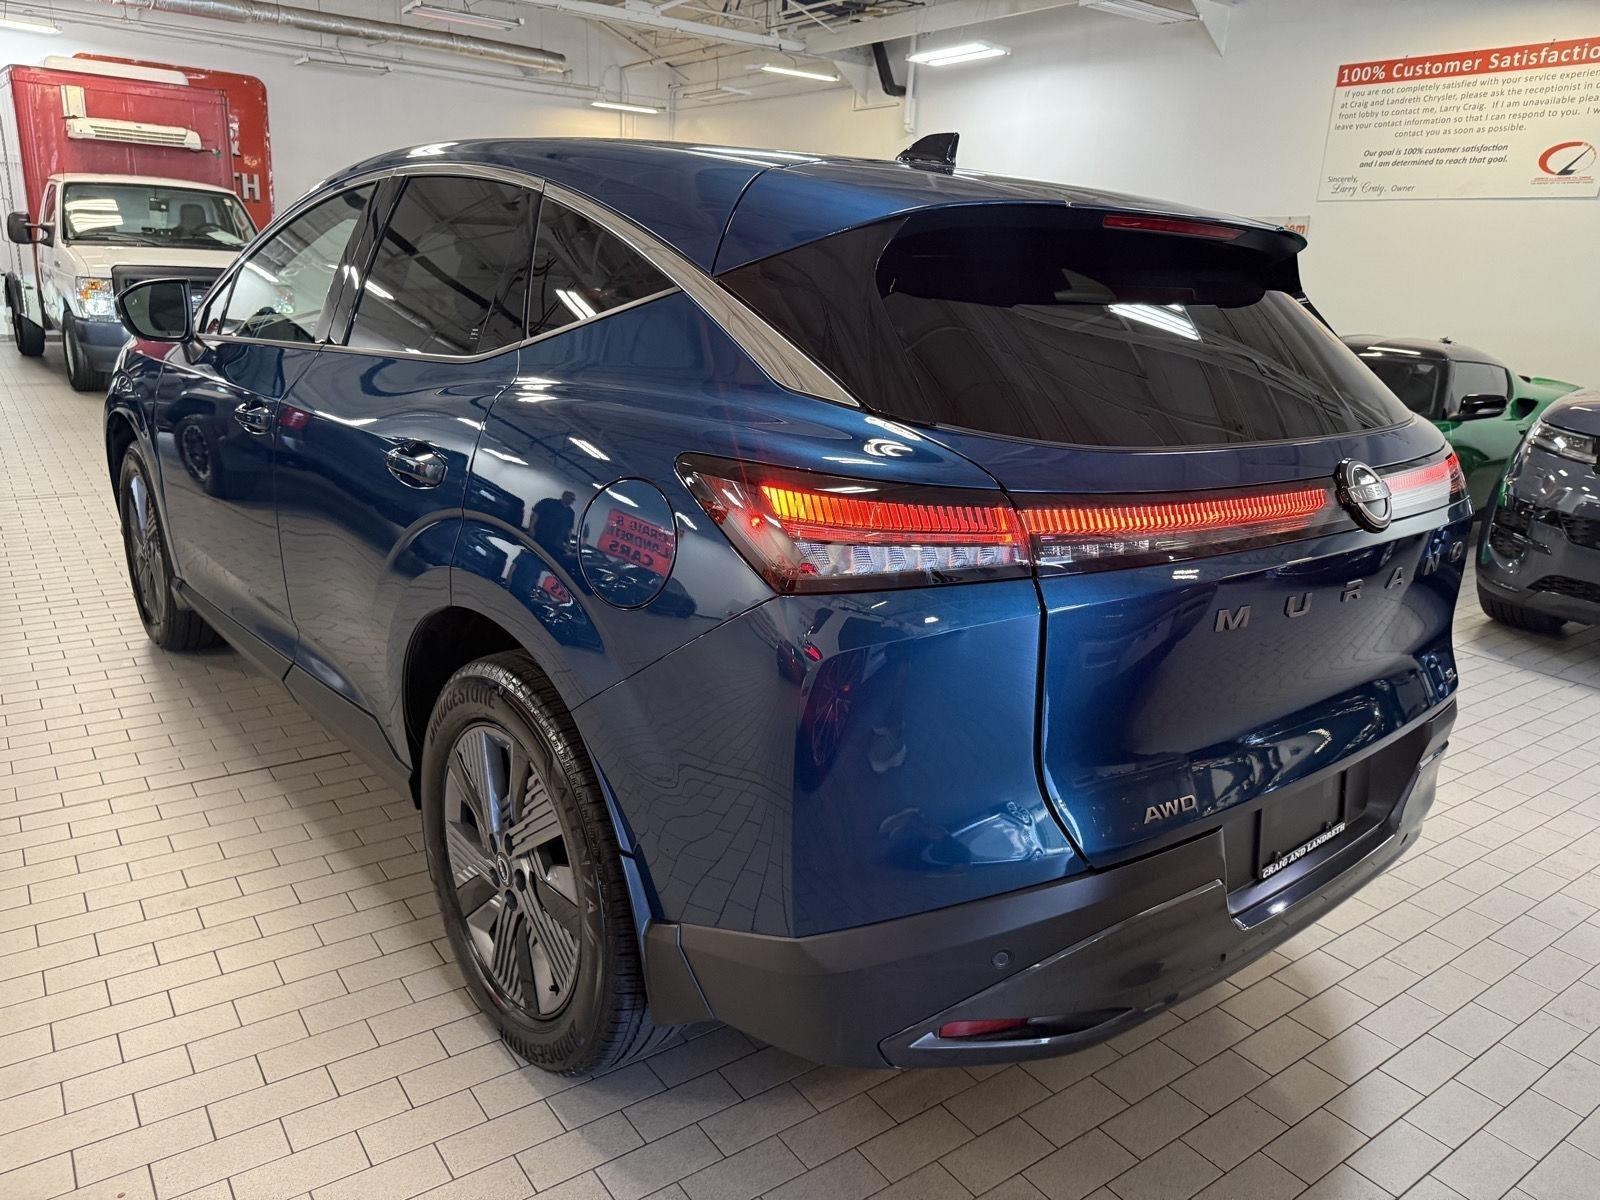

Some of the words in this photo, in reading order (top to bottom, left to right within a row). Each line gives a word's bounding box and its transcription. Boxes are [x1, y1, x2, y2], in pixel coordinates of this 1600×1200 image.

[1341, 64, 1386, 83] 100%
[1392, 58, 1482, 78] Customer
[1340, 100, 1348, 108] at
[1350, 100, 1368, 110] Craig
[1370, 98, 1384, 106] and
[1386, 94, 1420, 106] Landreth
[1423, 92, 1458, 103] Chrysler,
[1460, 90, 1488, 100] please
[1490, 88, 1505, 97] ask
[1508, 86, 1522, 96] the
[1524, 82, 1582, 95] receptionist
[1584, 81, 1593, 89] in
[1352, 90, 1365, 98] you
[1382, 87, 1394, 95] not
[1396, 83, 1440, 96] completely
[1442, 80, 1478, 90] satisfied
[1480, 78, 1499, 86] with
[1502, 76, 1521, 86] your
[1524, 72, 1556, 82] service
[1338, 110, 1356, 119] front
[1358, 110, 1380, 119] lobby
[1382, 109, 1389, 117] to
[1391, 107, 1420, 116] contact
[1440, 104, 1461, 113] Larry
[1462, 102, 1486, 112] Craig.
[1492, 100, 1499, 108] If
[1522, 96, 1576, 106] unavailable
[1334, 122, 1354, 131] leave
[1355, 123, 1372, 131] your
[1374, 120, 1402, 128] contact
[1404, 116, 1451, 126] information
[1466, 114, 1483, 122] that
[1490, 112, 1506, 120] can
[1508, 110, 1546, 120] respond
[1548, 109, 1558, 117] to
[1560, 110, 1580, 118] you.
[1394, 128, 1423, 138] contact
[1426, 128, 1440, 137] you
[1454, 126, 1474, 134] soon
[1488, 122, 1526, 134] possible.
[1378, 148, 1395, 158] goal
[1403, 147, 1424, 156] 100%
[1424, 146, 1460, 154] customer
[1461, 144, 1508, 153] satisfaction
[1392, 158, 1434, 167] determined
[1445, 156, 1468, 164] reach
[1488, 155, 1508, 164] goal.
[1328, 176, 1358, 184] Sincerely,
[1330, 183, 1358, 198] Larry
[1390, 184, 1415, 192] Owner
[1214, 541, 1464, 632] MURANO
[1144, 794, 1197, 824] AWD
[1262, 859, 1288, 878] CRAIG
[1288, 847, 1306, 864] AND
[1306, 822, 1346, 852] LANDRETH
